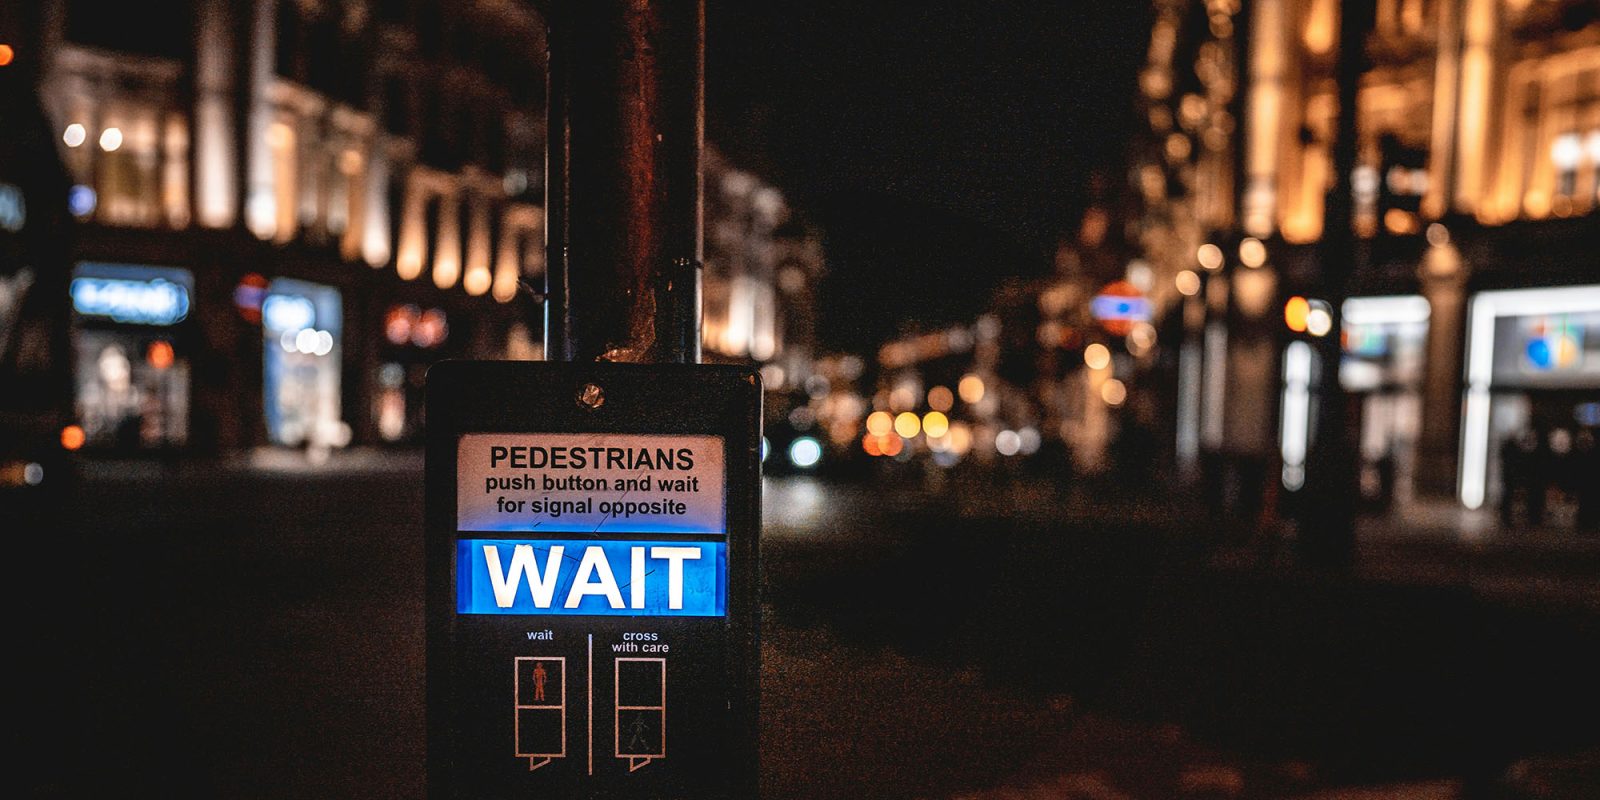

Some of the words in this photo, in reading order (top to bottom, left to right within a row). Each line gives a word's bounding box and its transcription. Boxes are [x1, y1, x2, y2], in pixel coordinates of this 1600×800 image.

[490, 446, 694, 471] PEDESTRIANS
[485, 475, 536, 493] push
[543, 474, 608, 491] button
[614, 475, 651, 492] and
[657, 476, 699, 492] wait
[497, 497, 525, 514] for
[531, 498, 592, 517] signal
[599, 498, 687, 518] opposite
[482, 544, 702, 610] WAIT
[526, 629, 554, 640] wait
[622, 631, 659, 641] cross
[611, 641, 638, 653] with
[641, 643, 670, 653] care
